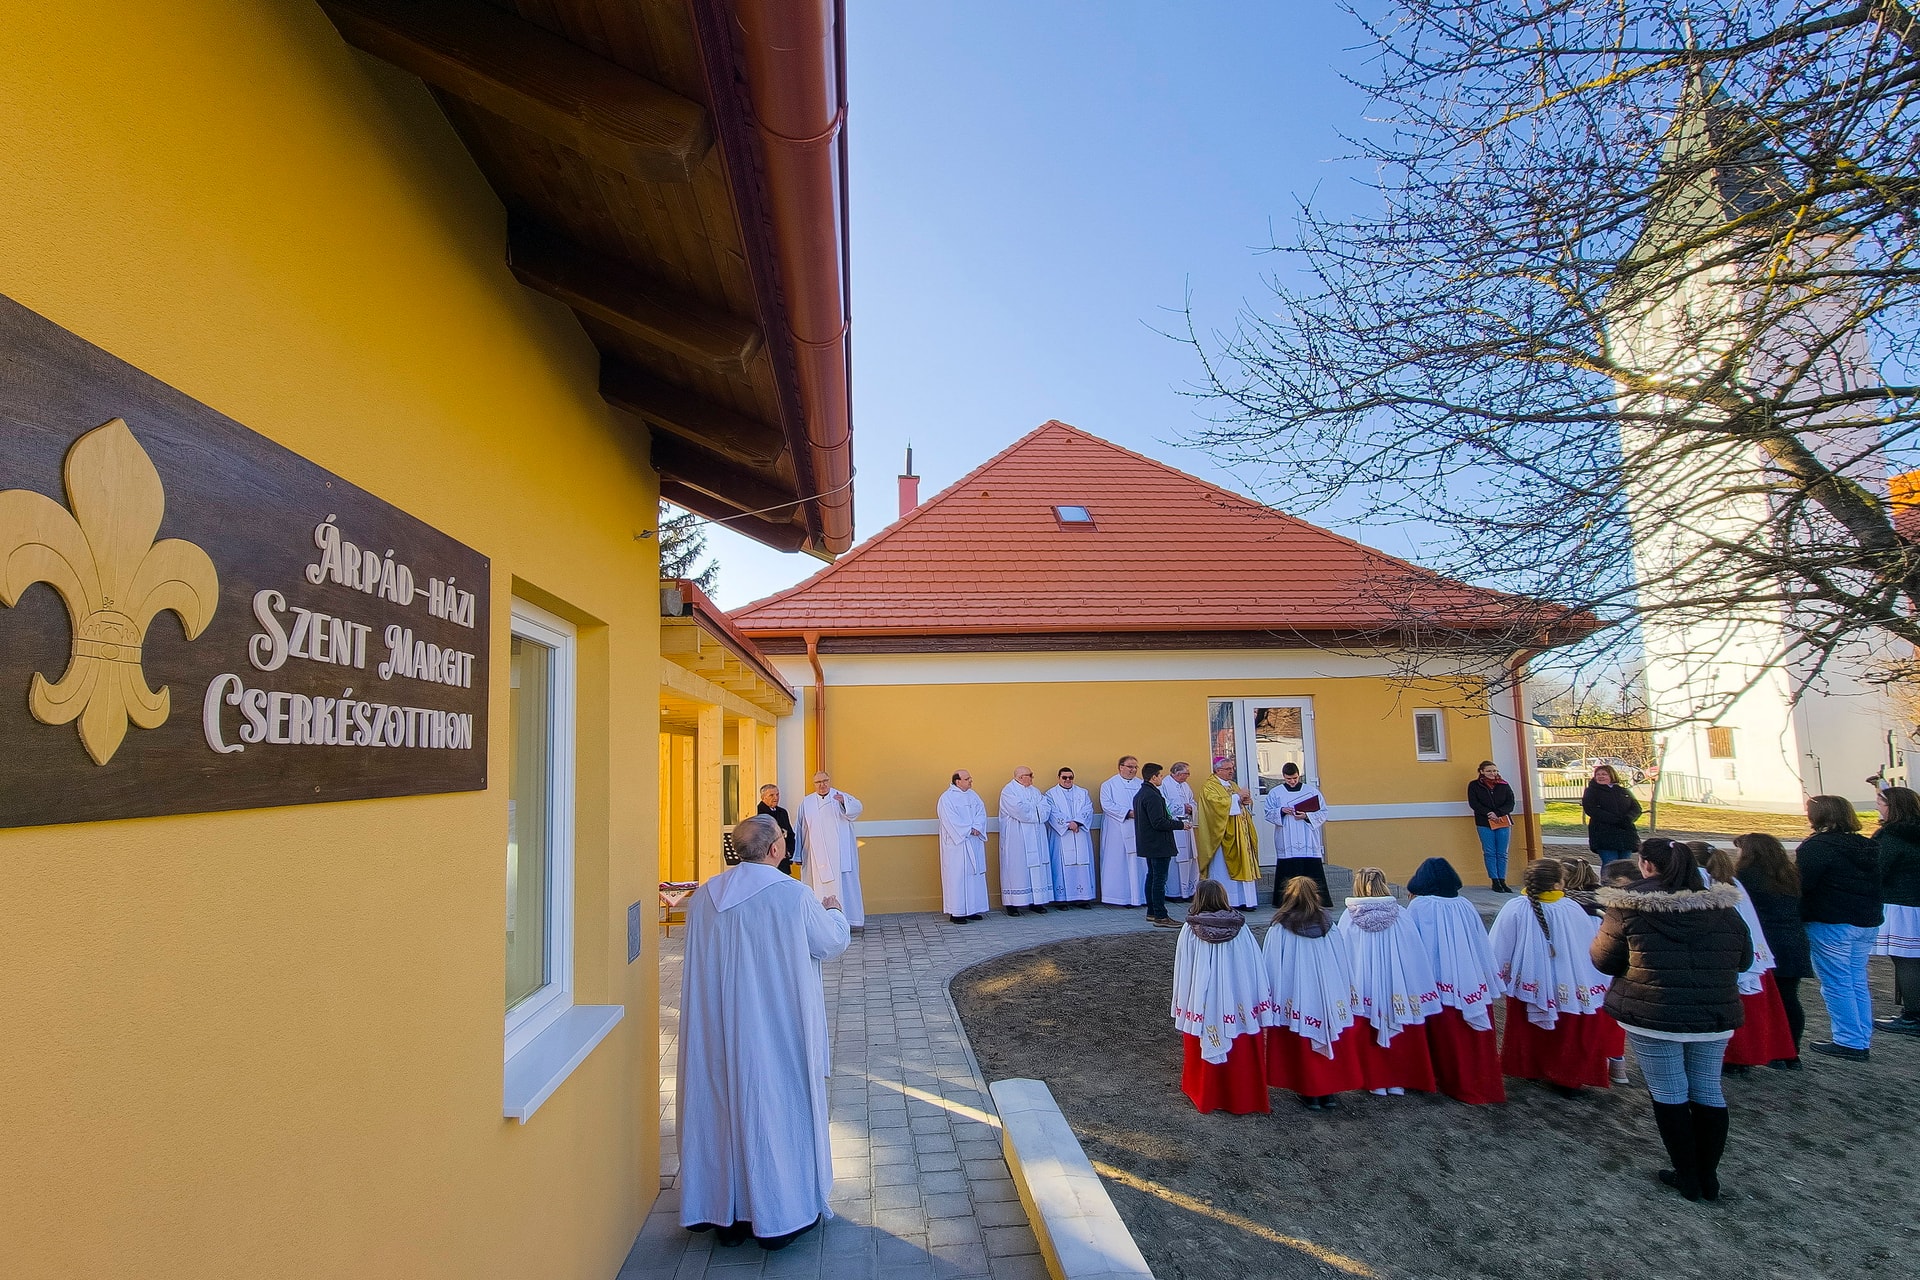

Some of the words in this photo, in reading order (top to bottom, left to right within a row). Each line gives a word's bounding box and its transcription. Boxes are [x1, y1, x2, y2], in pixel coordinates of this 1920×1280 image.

[306, 513, 475, 629] ÁRPÁD-HÁZI
[249, 590, 372, 672] SZENT
[378, 624, 475, 689] MARGIT
[203, 673, 473, 754] CSERKÉSZOTTHON
